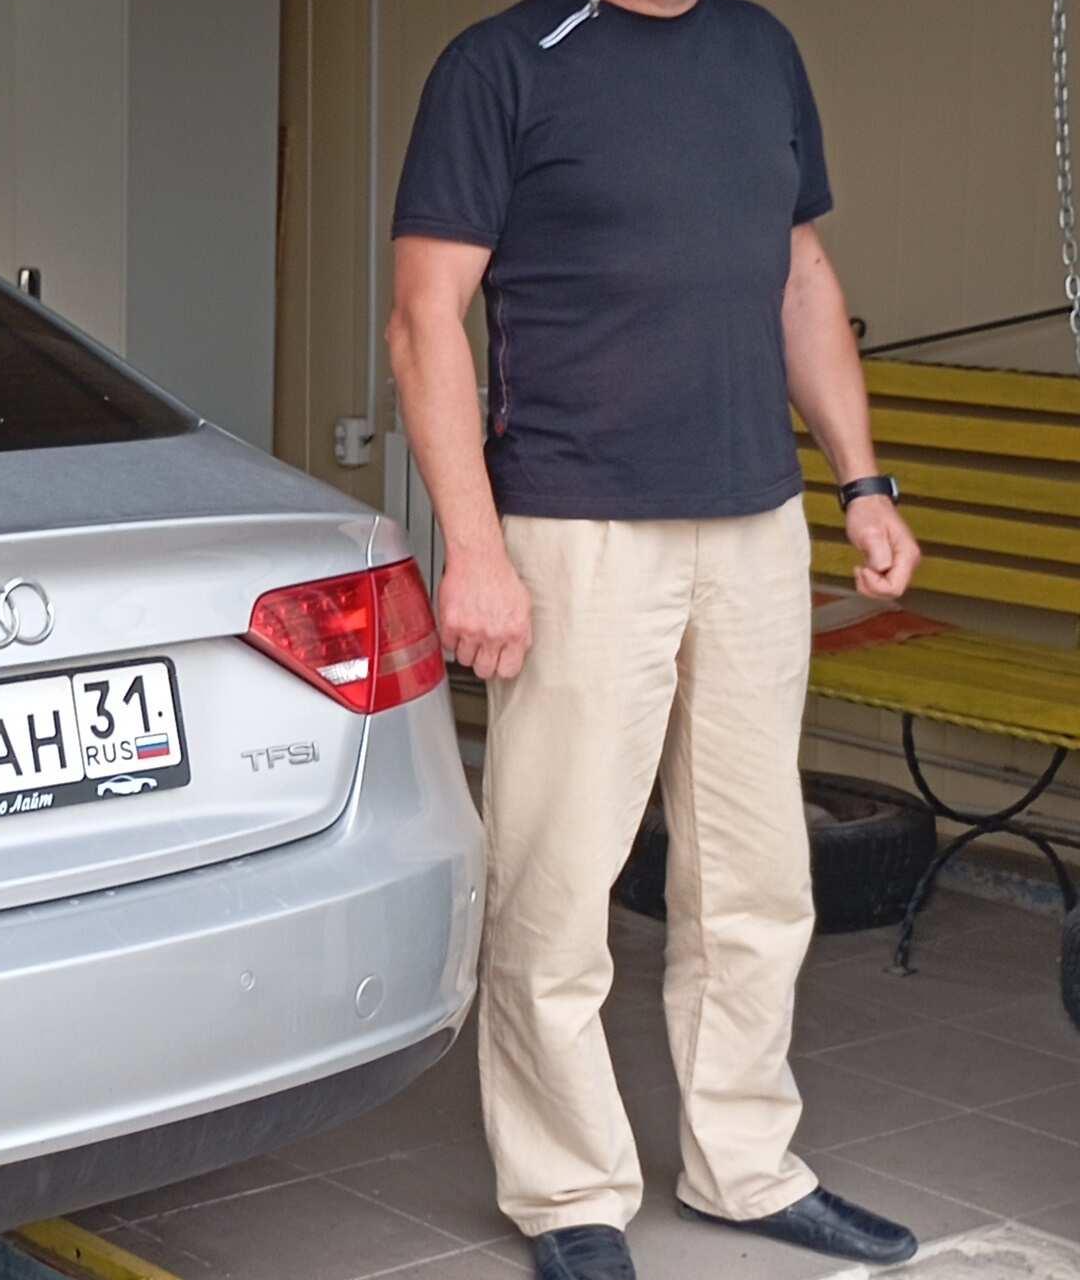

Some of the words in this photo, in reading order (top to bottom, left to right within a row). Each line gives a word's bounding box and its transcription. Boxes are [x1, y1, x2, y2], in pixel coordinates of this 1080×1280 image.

[84, 675, 151, 739] 31
[86, 741, 134, 766] RUS
[240, 740, 321, 773] TFSI
[9, 791, 54, 814] Лайт
